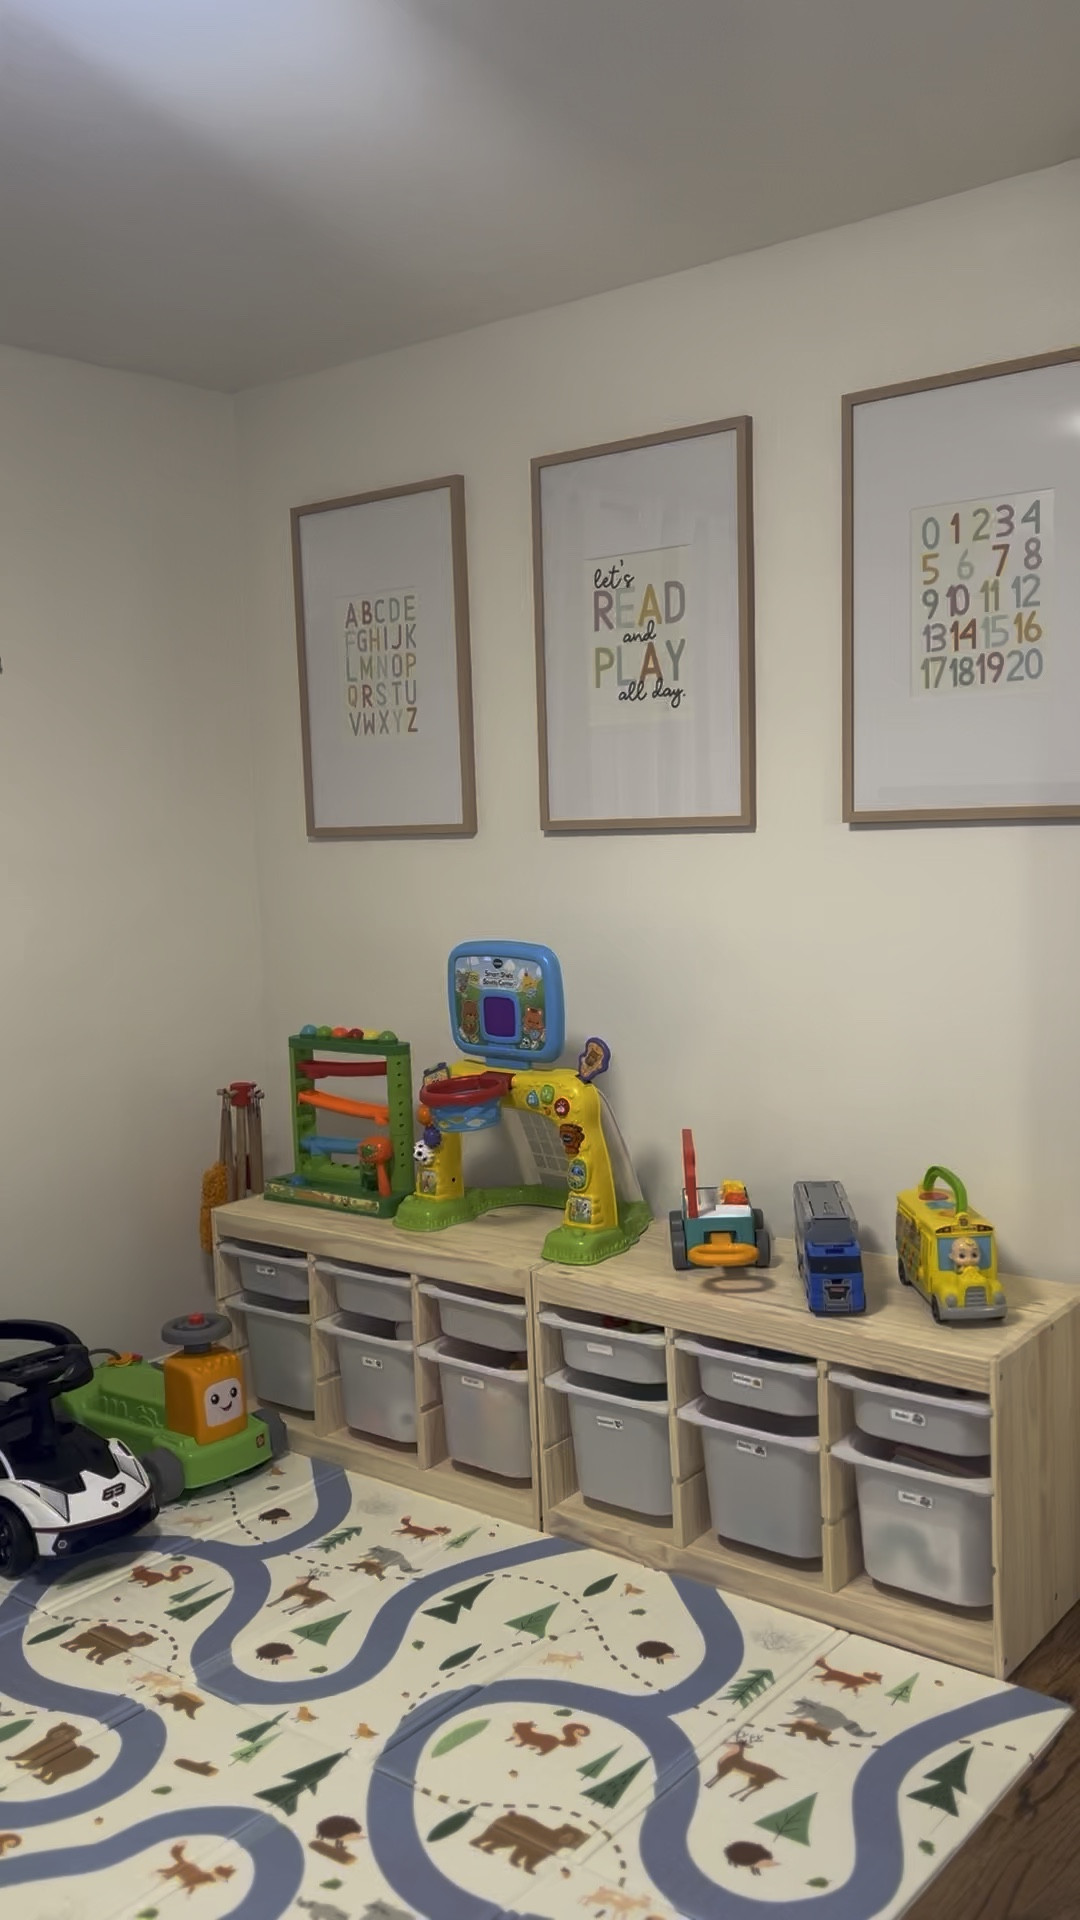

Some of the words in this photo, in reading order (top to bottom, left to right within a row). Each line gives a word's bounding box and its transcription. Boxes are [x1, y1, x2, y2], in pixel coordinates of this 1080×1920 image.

[922, 517, 940, 550] 0
[950, 512, 960, 544] 1
[972, 508, 991, 541] 2
[996, 504, 1015, 538] 3
[1021, 499, 1041, 534] 4
[593, 559, 635, 589] let's
[922, 553, 940, 585] 5
[957, 548, 974, 580] 6
[992, 543, 1010, 577] 7
[1024, 537, 1042, 570] 8
[593, 580, 686, 632] READ
[922, 588, 939, 620] 9
[946, 583, 970, 617] 10
[980, 579, 1000, 612] 11
[1011, 573, 1041, 608] 12
[622, 619, 656, 643] and
[922, 622, 947, 652] 13
[950, 618, 977, 652] 14
[981, 614, 1009, 649] 15
[1014, 610, 1042, 644] 16
[594, 638, 686, 689] PLAY
[920, 656, 947, 689] 17
[950, 656, 975, 687] 18
[976, 651, 1005, 684] 19
[1006, 647, 1043, 682] 20
[618, 680, 647, 701] all
[101, 1482, 126, 1501] 63
